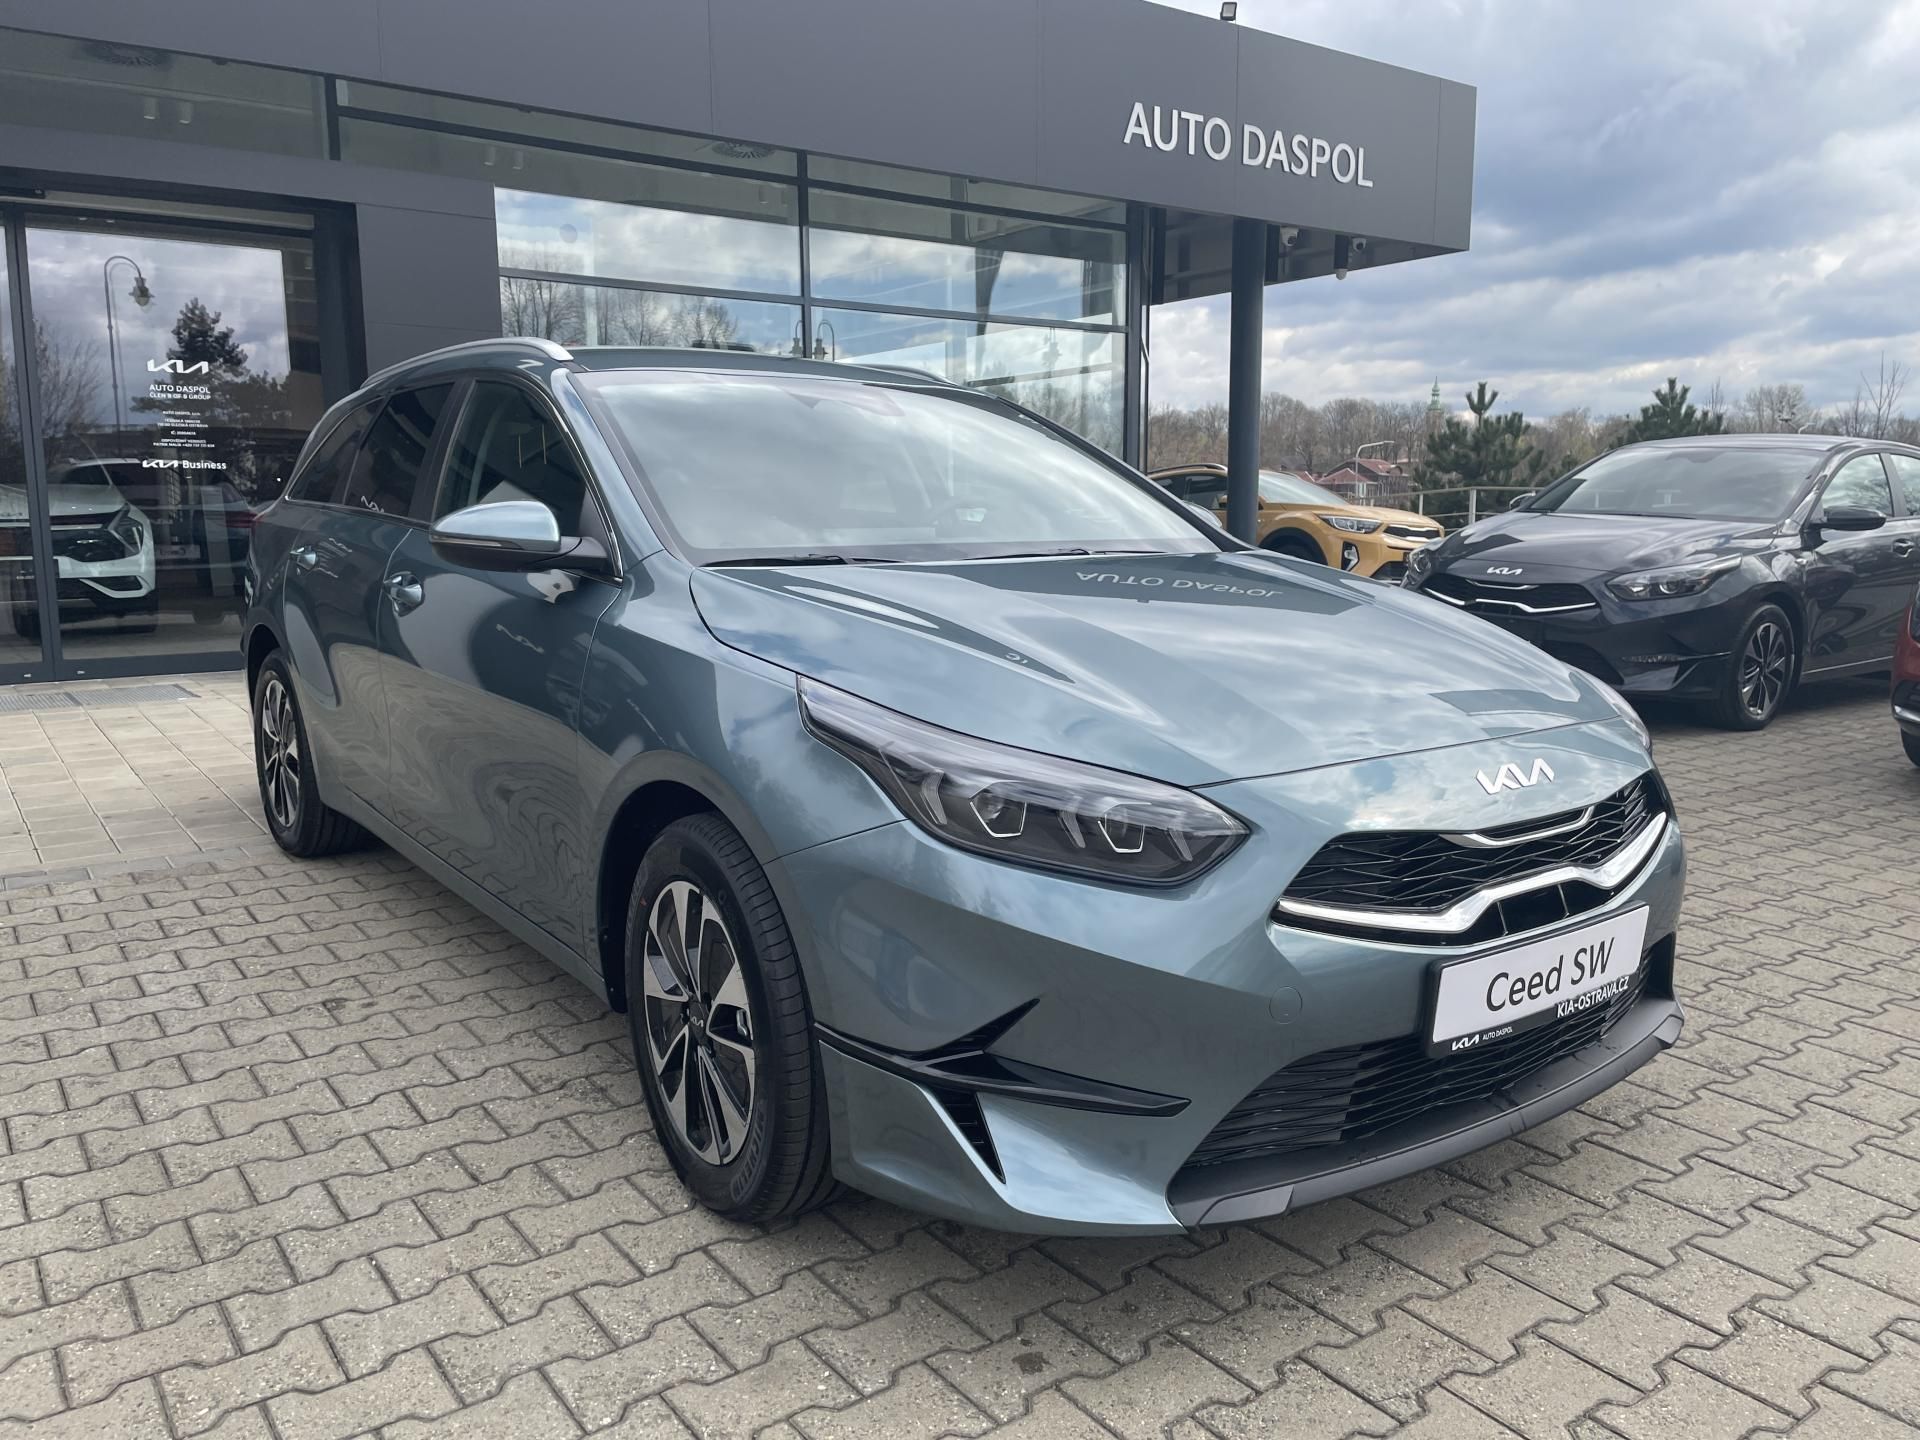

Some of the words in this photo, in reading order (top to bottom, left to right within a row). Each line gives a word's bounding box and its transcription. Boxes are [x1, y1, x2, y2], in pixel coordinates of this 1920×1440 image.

[1123, 102, 1232, 161] AUTO
[1242, 124, 1374, 188] DASPOL
[147, 359, 209, 374] KIA
[149, 383, 174, 392] AUTO
[176, 385, 211, 394] DASPOL
[142, 460, 178, 468] KIA
[182, 460, 227, 469] Business
[1486, 566, 1523, 575] KIA
[1476, 758, 1555, 795] KIA
[1486, 954, 1564, 1012] Ceed
[1571, 937, 1615, 985] SW
[1557, 975, 1629, 1018] KIA-OSTRAVA.CZ
[1452, 1034, 1480, 1050] KIA
[1482, 1031, 1496, 1040] AUTO
[1496, 1026, 1513, 1037] DASPOL
